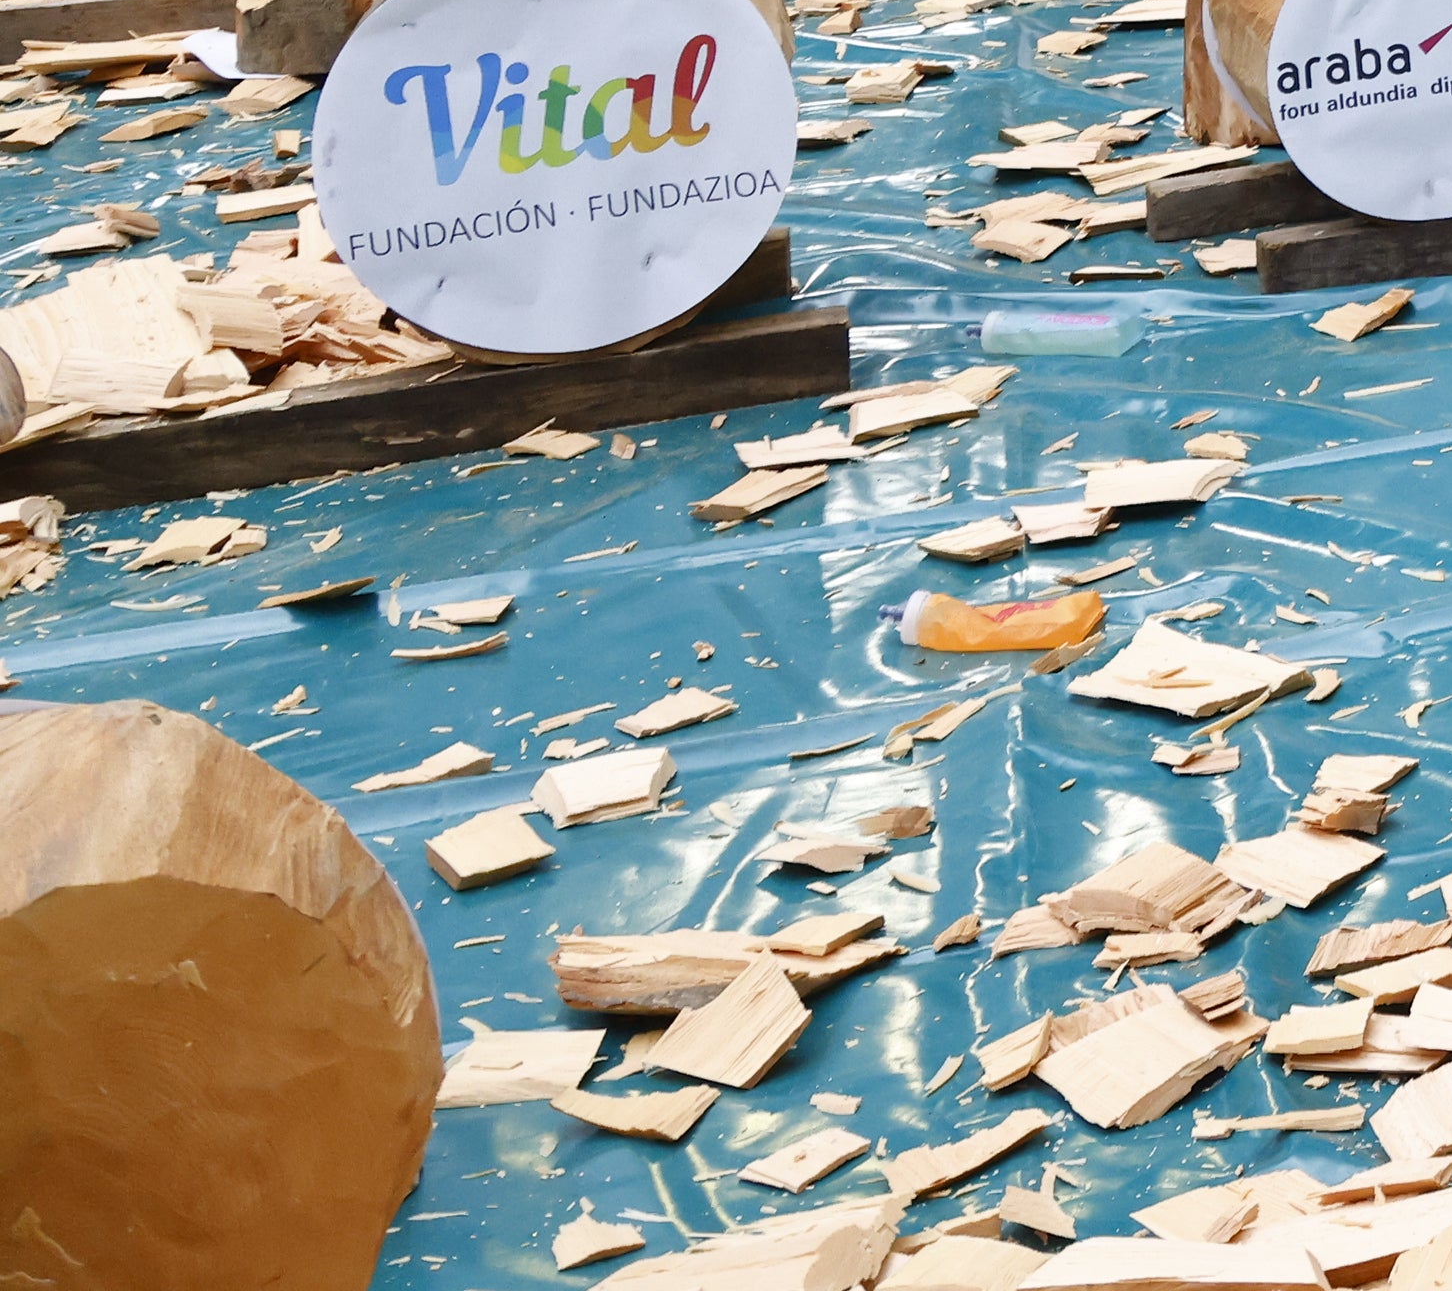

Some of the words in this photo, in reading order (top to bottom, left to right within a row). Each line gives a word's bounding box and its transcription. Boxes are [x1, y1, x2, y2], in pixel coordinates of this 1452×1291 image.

[1276, 38, 1413, 95] araba
[1278, 99, 1322, 124] foru
[1326, 82, 1420, 116] aldundia
[383, 33, 718, 188] Vital
[348, 197, 559, 263] FUNDACIÓN
[587, 166, 783, 225] FUNDAZIOA
